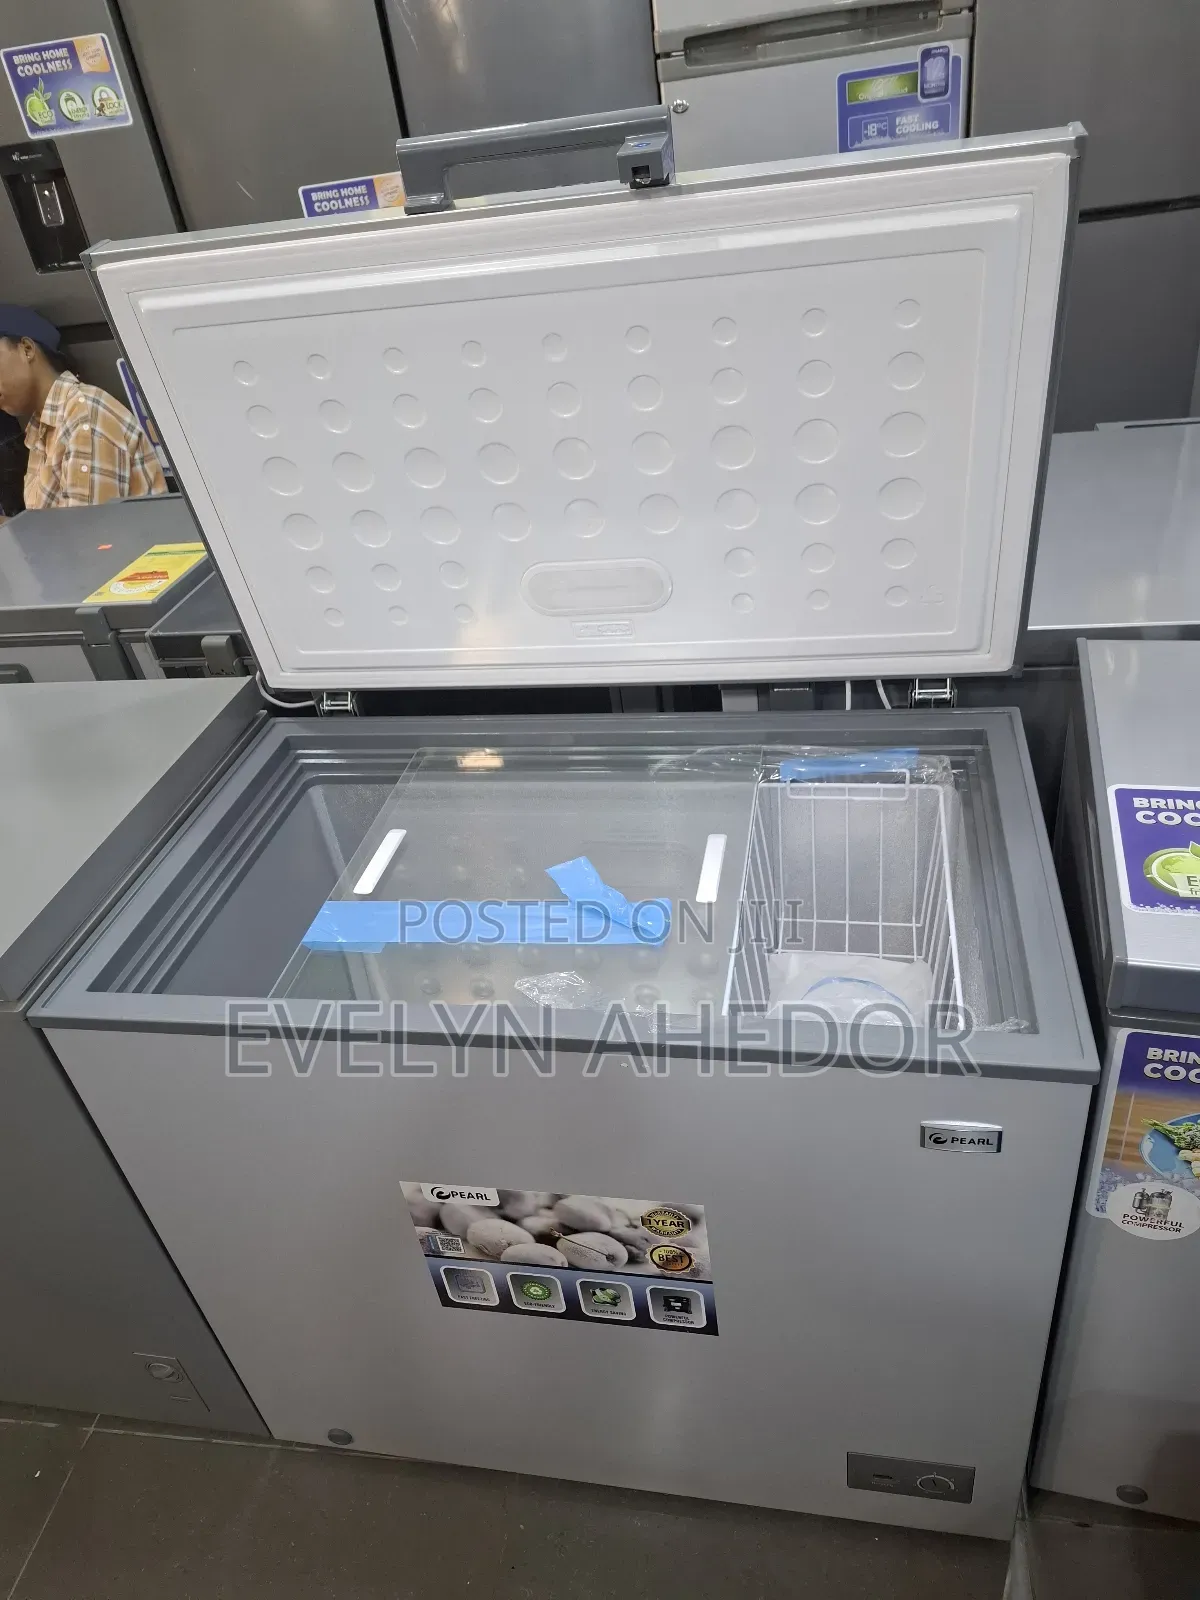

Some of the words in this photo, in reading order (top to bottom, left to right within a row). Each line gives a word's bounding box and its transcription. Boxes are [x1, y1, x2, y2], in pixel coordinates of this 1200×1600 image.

[12, 52, 42, 65] BRING
[41, 47, 69, 60] HOME
[17, 59, 73, 77] COOLNESS
[896, 114, 919, 125] FAST
[896, 121, 939, 134] COOLING
[311, 190, 340, 201] BRING
[340, 185, 367, 197] HOME
[314, 195, 370, 212] COOLNESS
[951, 1136, 994, 1146] PEARL
[450, 1190, 491, 1201] PEARL
[1121, 1219, 1183, 1234] COMPRESSOR
[1122, 1213, 1185, 1229] POWERFUL
[658, 1254, 684, 1263] BEST
